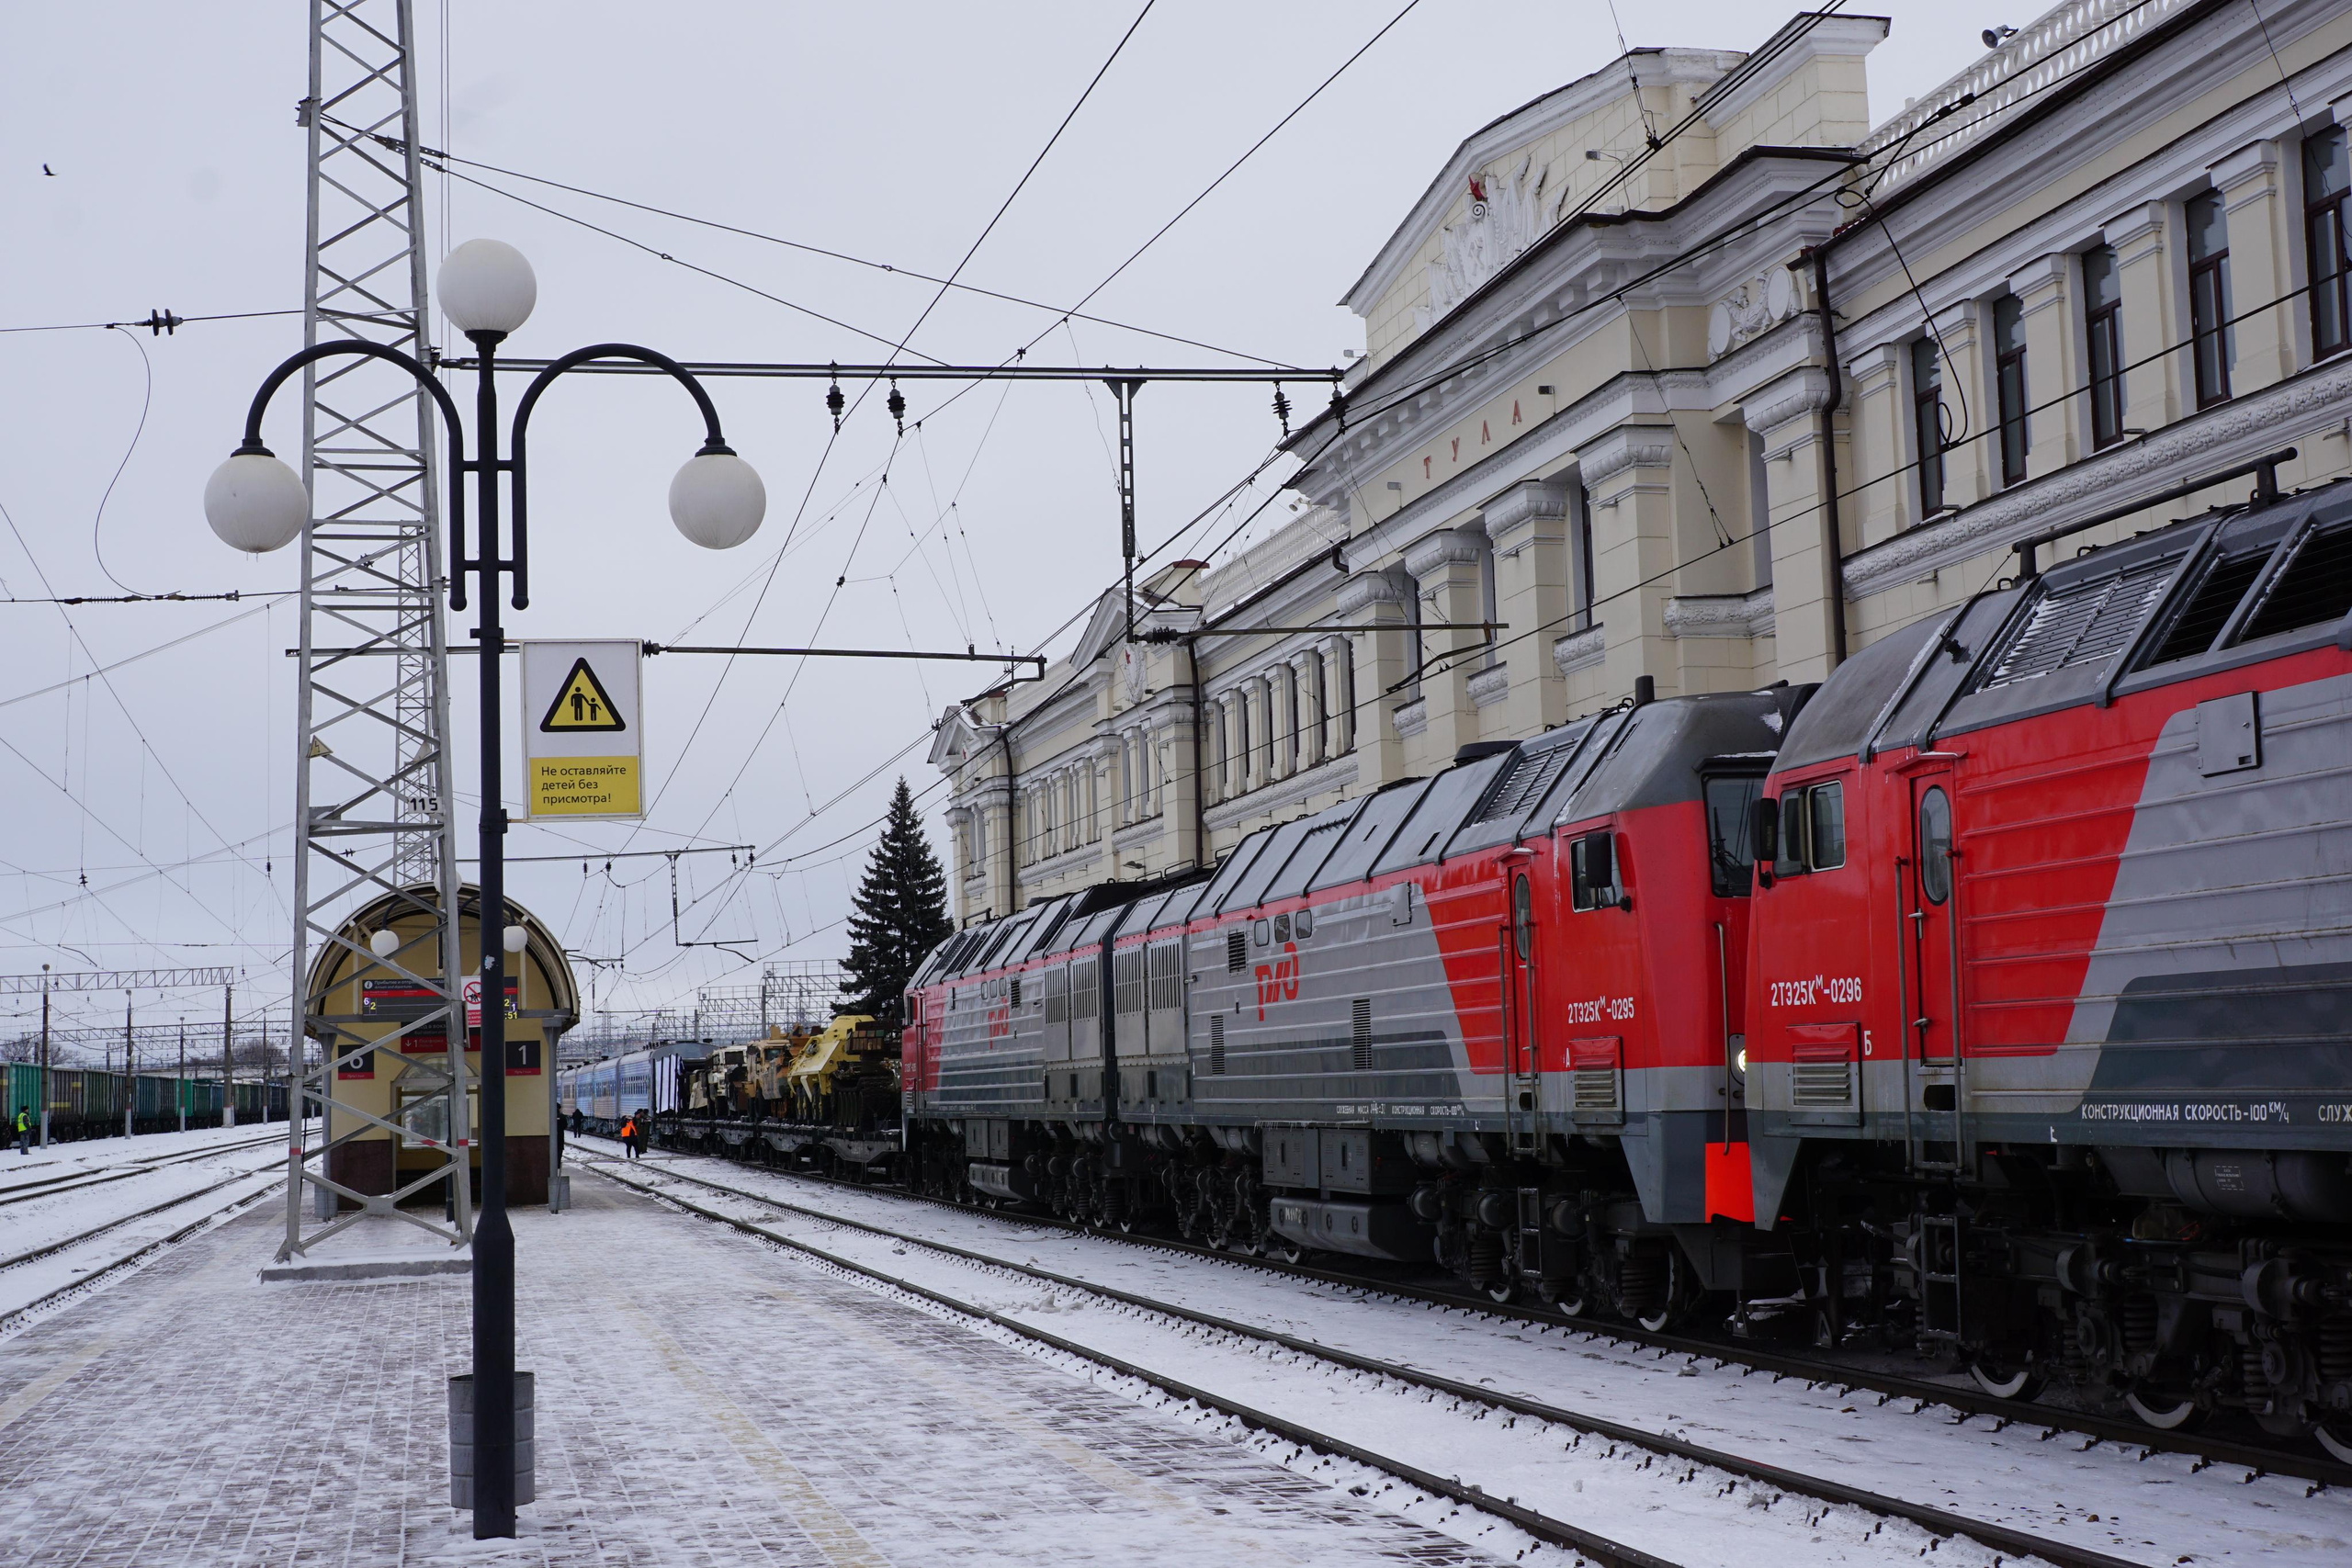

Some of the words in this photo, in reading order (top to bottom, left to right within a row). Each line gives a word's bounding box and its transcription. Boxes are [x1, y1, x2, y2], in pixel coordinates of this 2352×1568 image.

[541, 766, 558, 776] Не
[560, 764, 627, 776] оставляйте
[541, 779, 575, 792] детей
[578, 779, 598, 790] без
[410, 797, 438, 811] 115
[543, 793, 611, 806] присмотра!
[370, 1001, 376, 1010] 2
[413, 1039, 418, 1048] 1
[1863, 1030, 1872, 1056] Б
[518, 1044, 527, 1066] 1
[2081, 1104, 2179, 1122] КОНСТРУКЦИОННАЯ
